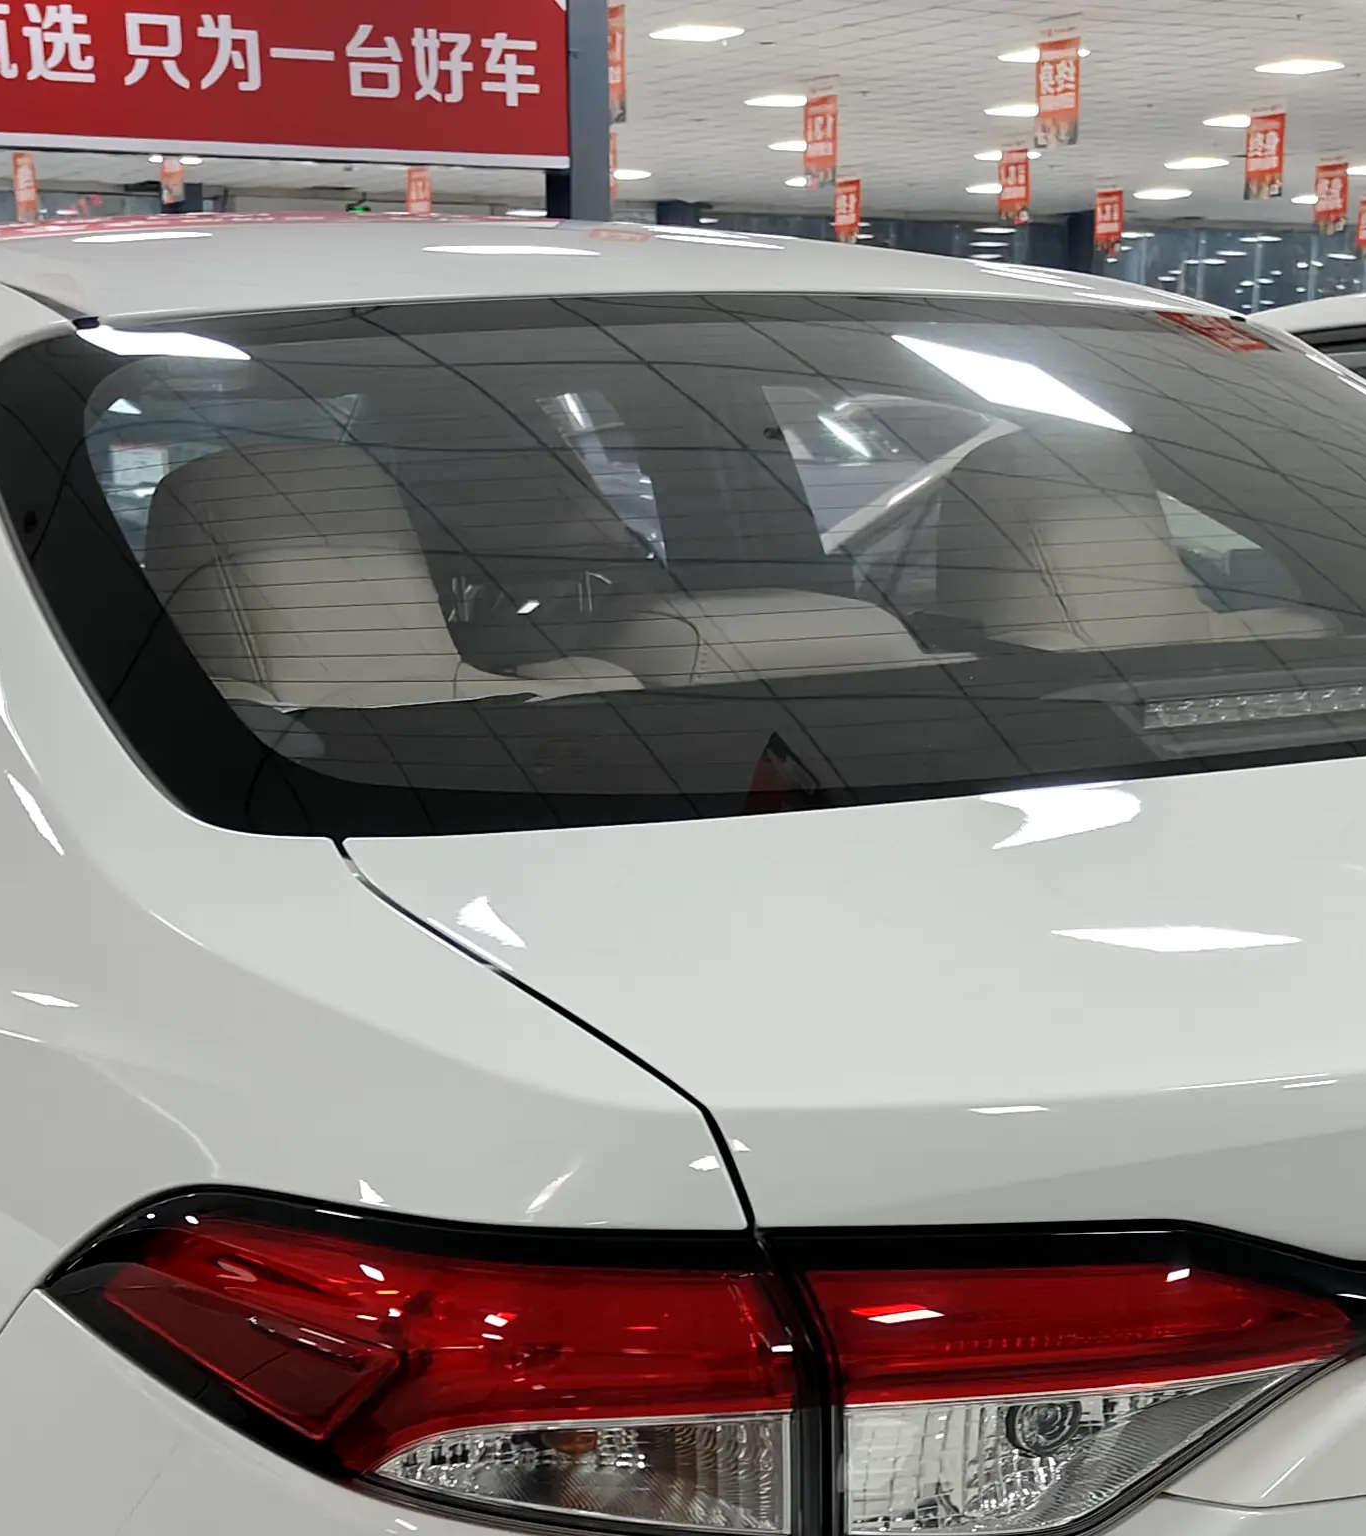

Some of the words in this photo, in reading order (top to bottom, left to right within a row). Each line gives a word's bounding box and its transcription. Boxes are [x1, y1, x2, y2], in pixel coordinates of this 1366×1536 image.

[124, 12, 540, 107] 只为一台好车
